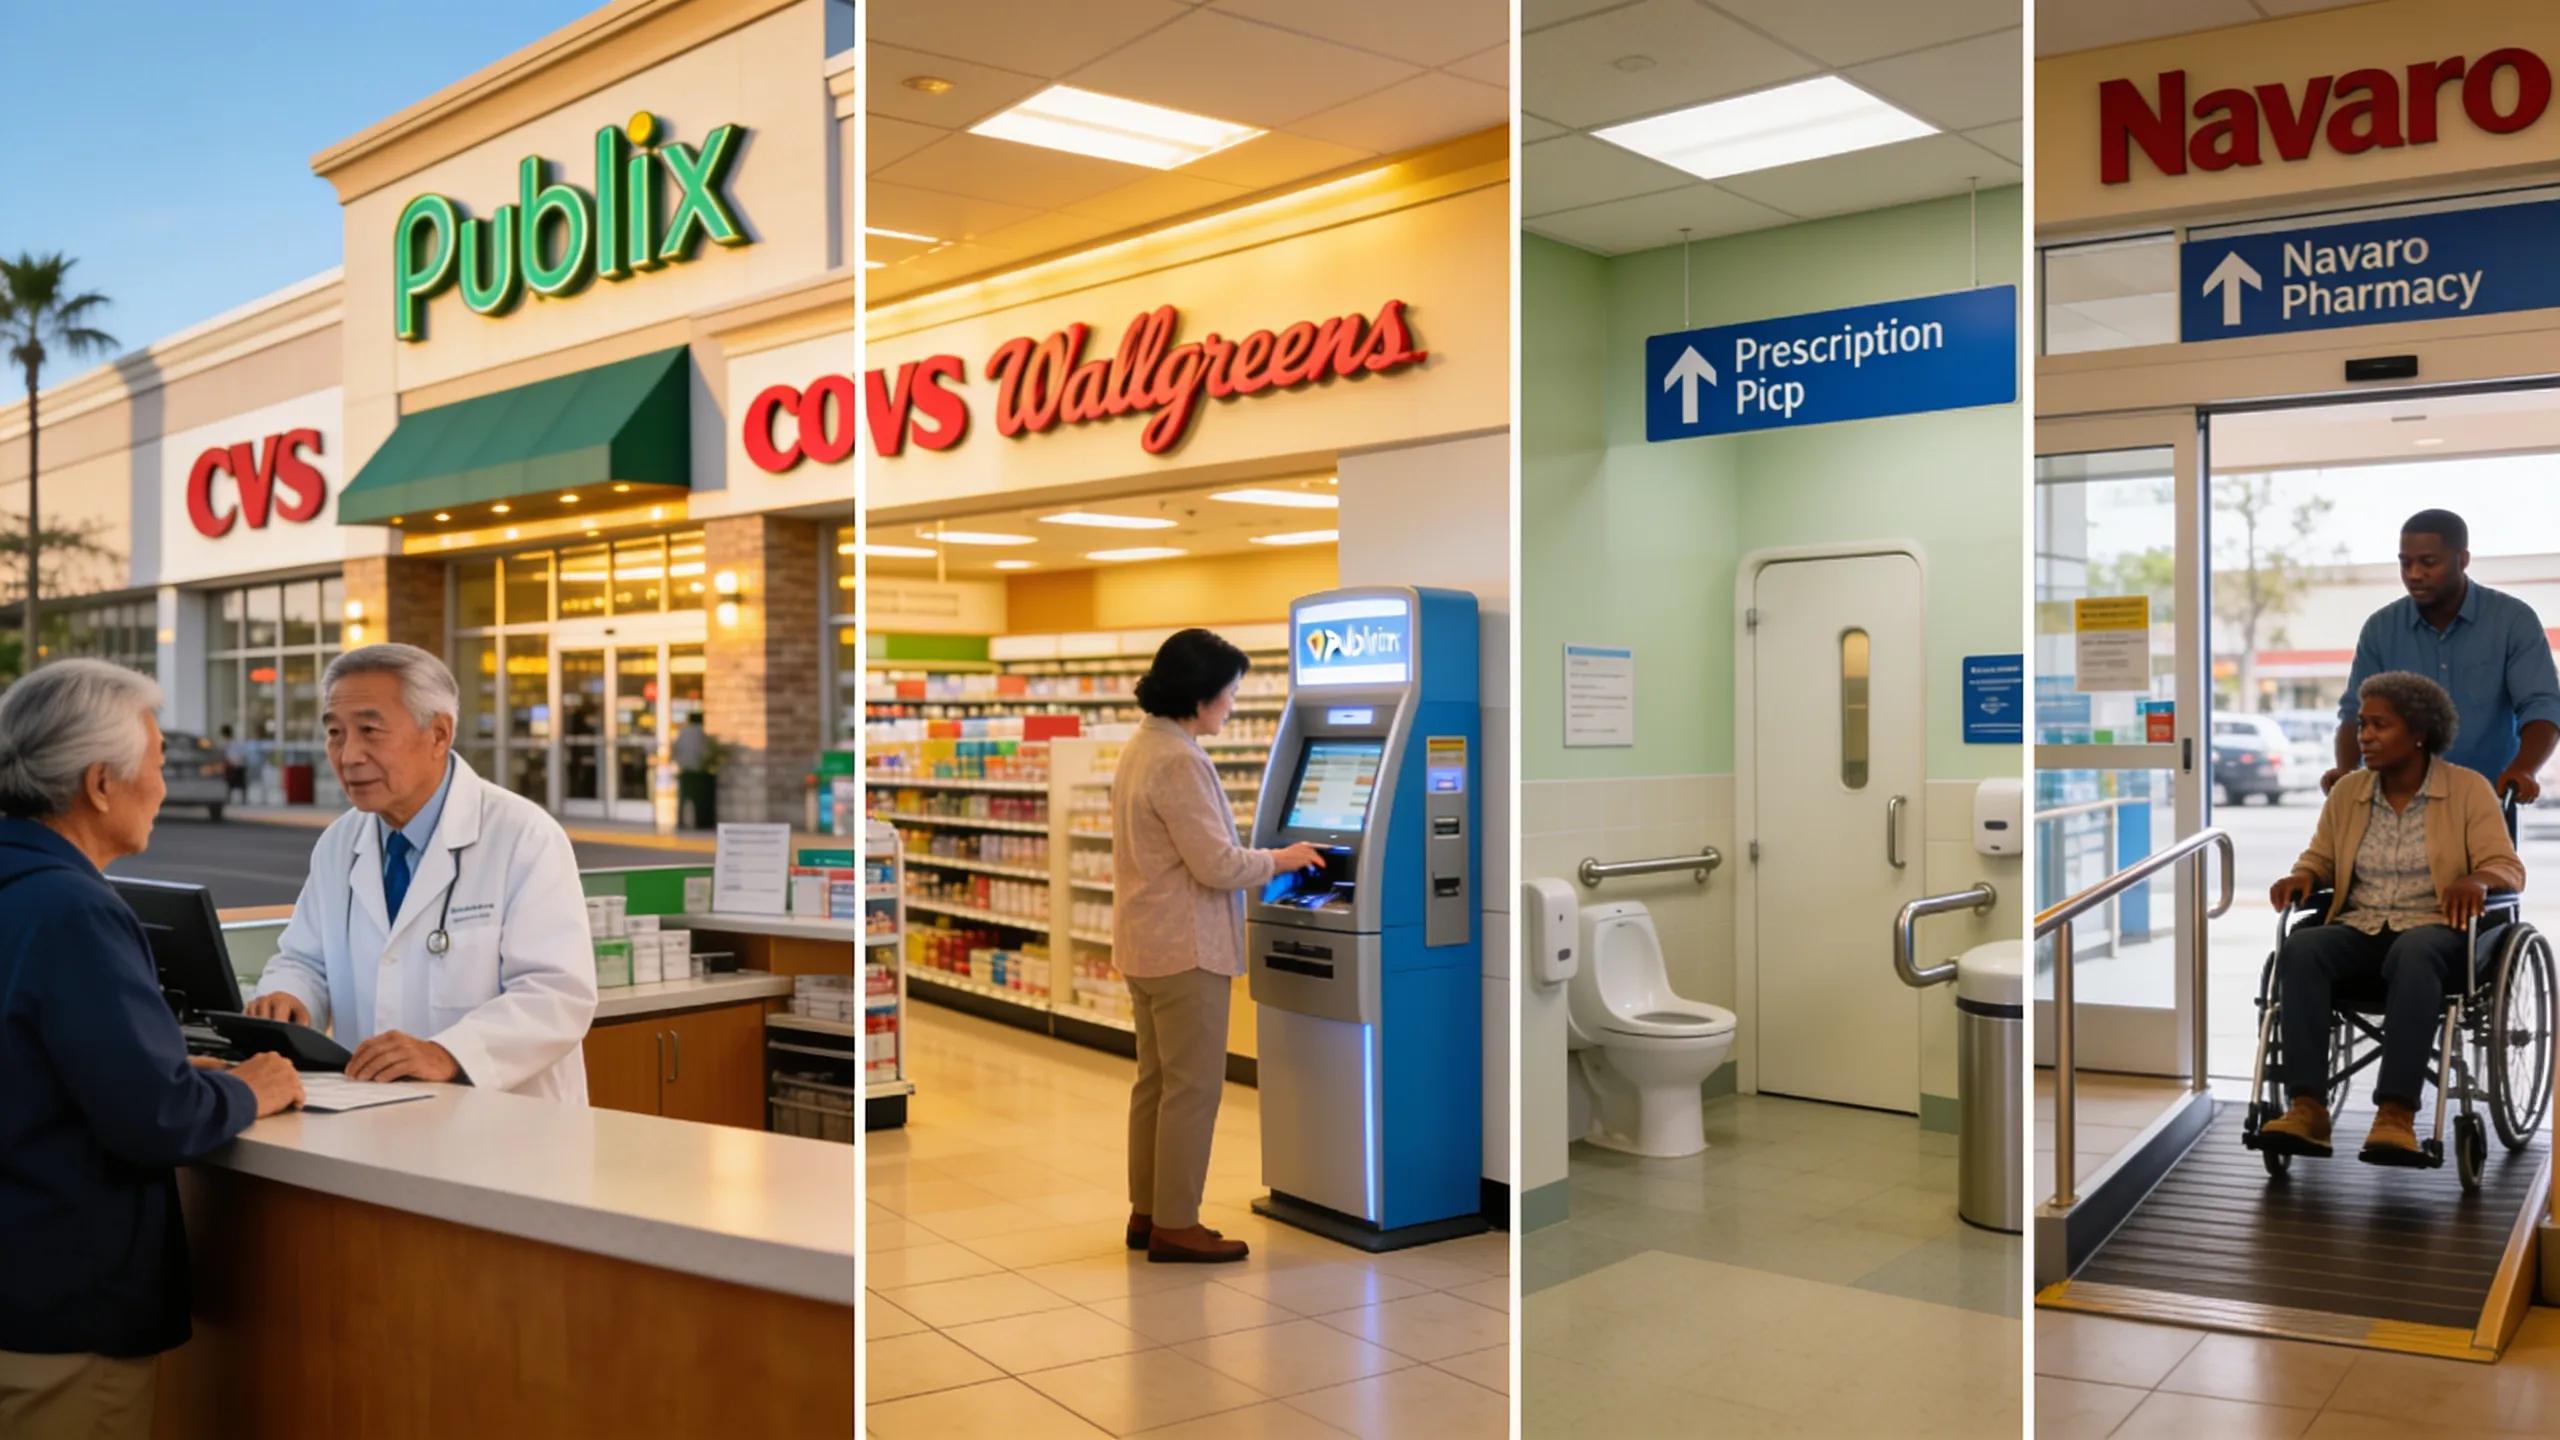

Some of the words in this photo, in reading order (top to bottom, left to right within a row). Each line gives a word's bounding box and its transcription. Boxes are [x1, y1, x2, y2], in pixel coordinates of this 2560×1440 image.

[2098, 47, 2552, 184] Navaro
[394, 110, 749, 341] Publix
[2283, 237, 2430, 278] Navaro
[2282, 270, 2484, 320] Pharmacy
[985, 299, 1428, 454] Wallgreens
[1735, 318, 1943, 373] Prescription
[1736, 377, 1805, 418] Picp
[187, 432, 327, 539] CVS
